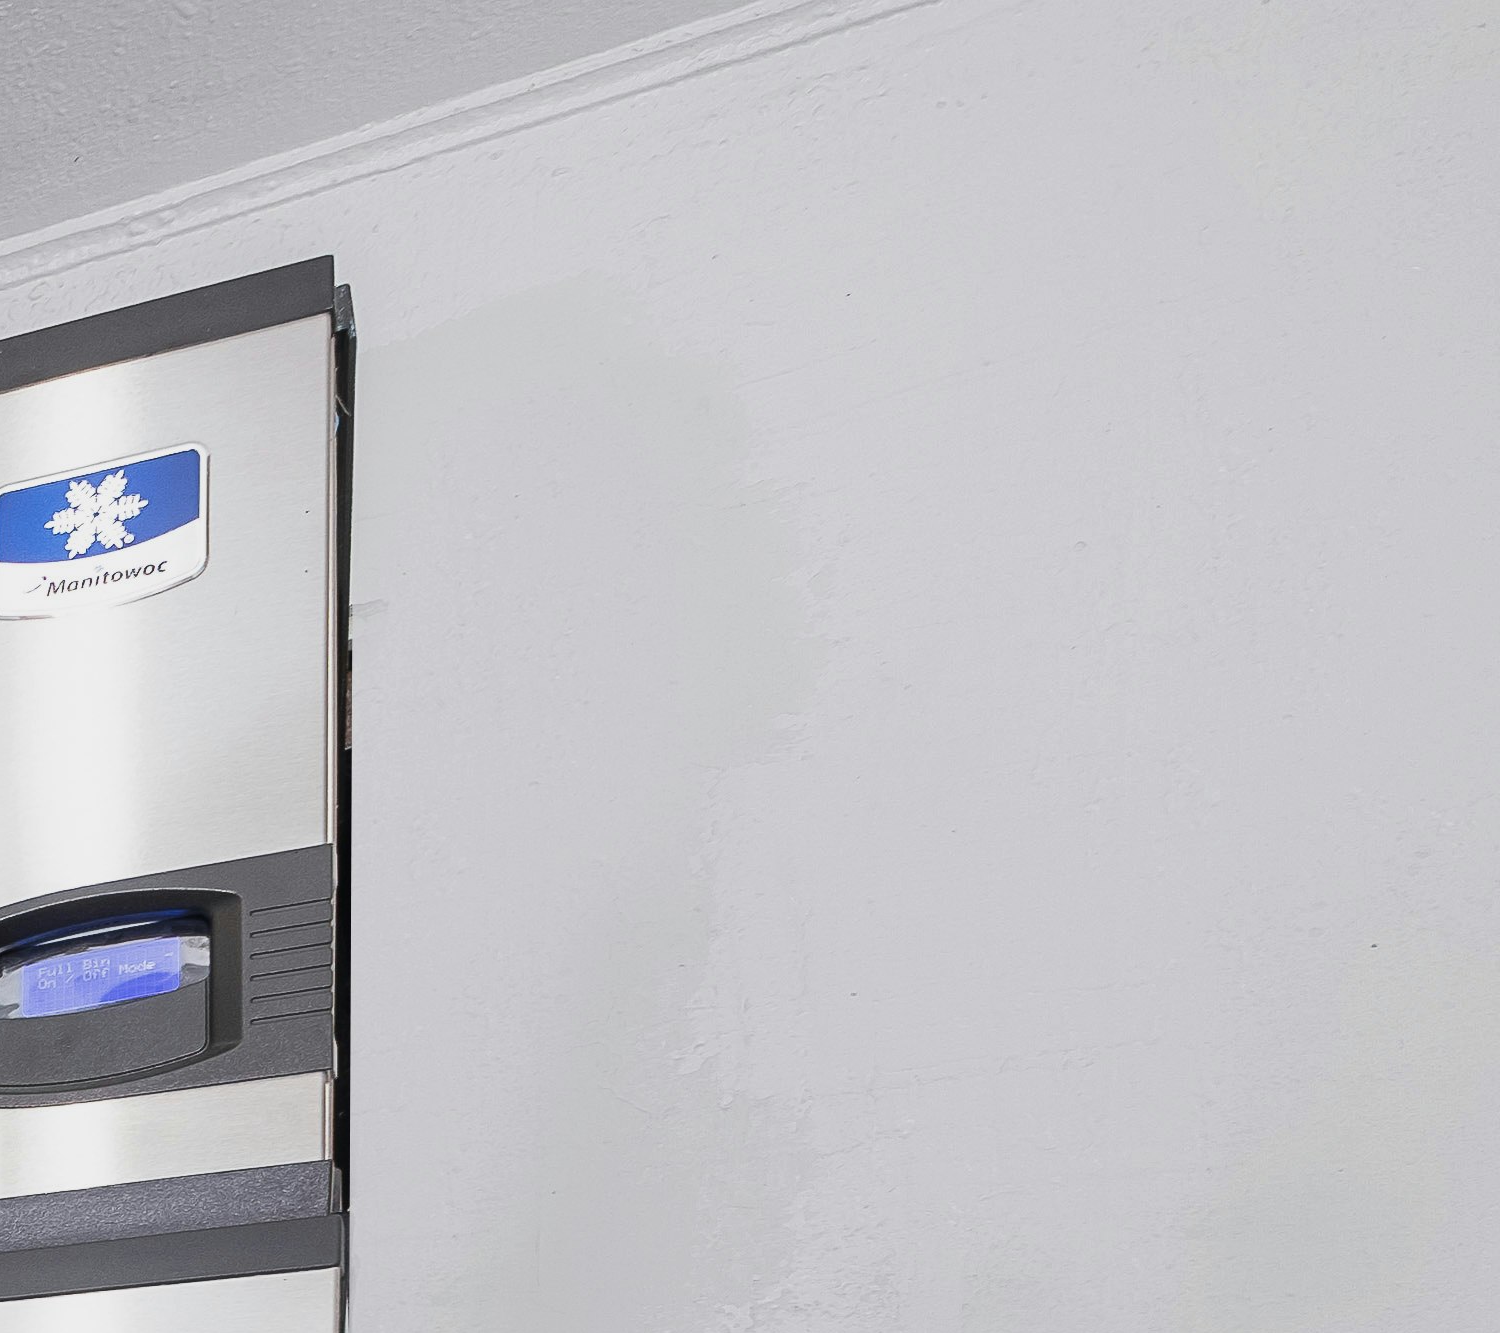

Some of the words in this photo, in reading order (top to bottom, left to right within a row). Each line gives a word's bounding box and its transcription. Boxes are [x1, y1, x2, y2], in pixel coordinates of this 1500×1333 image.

[46, 559, 169, 597] Manitowoc
[38, 962, 73, 979] Full
[82, 958, 110, 971] Bin
[38, 978, 56, 990] On
[82, 967, 110, 981] Off
[118, 960, 157, 975] Mode
